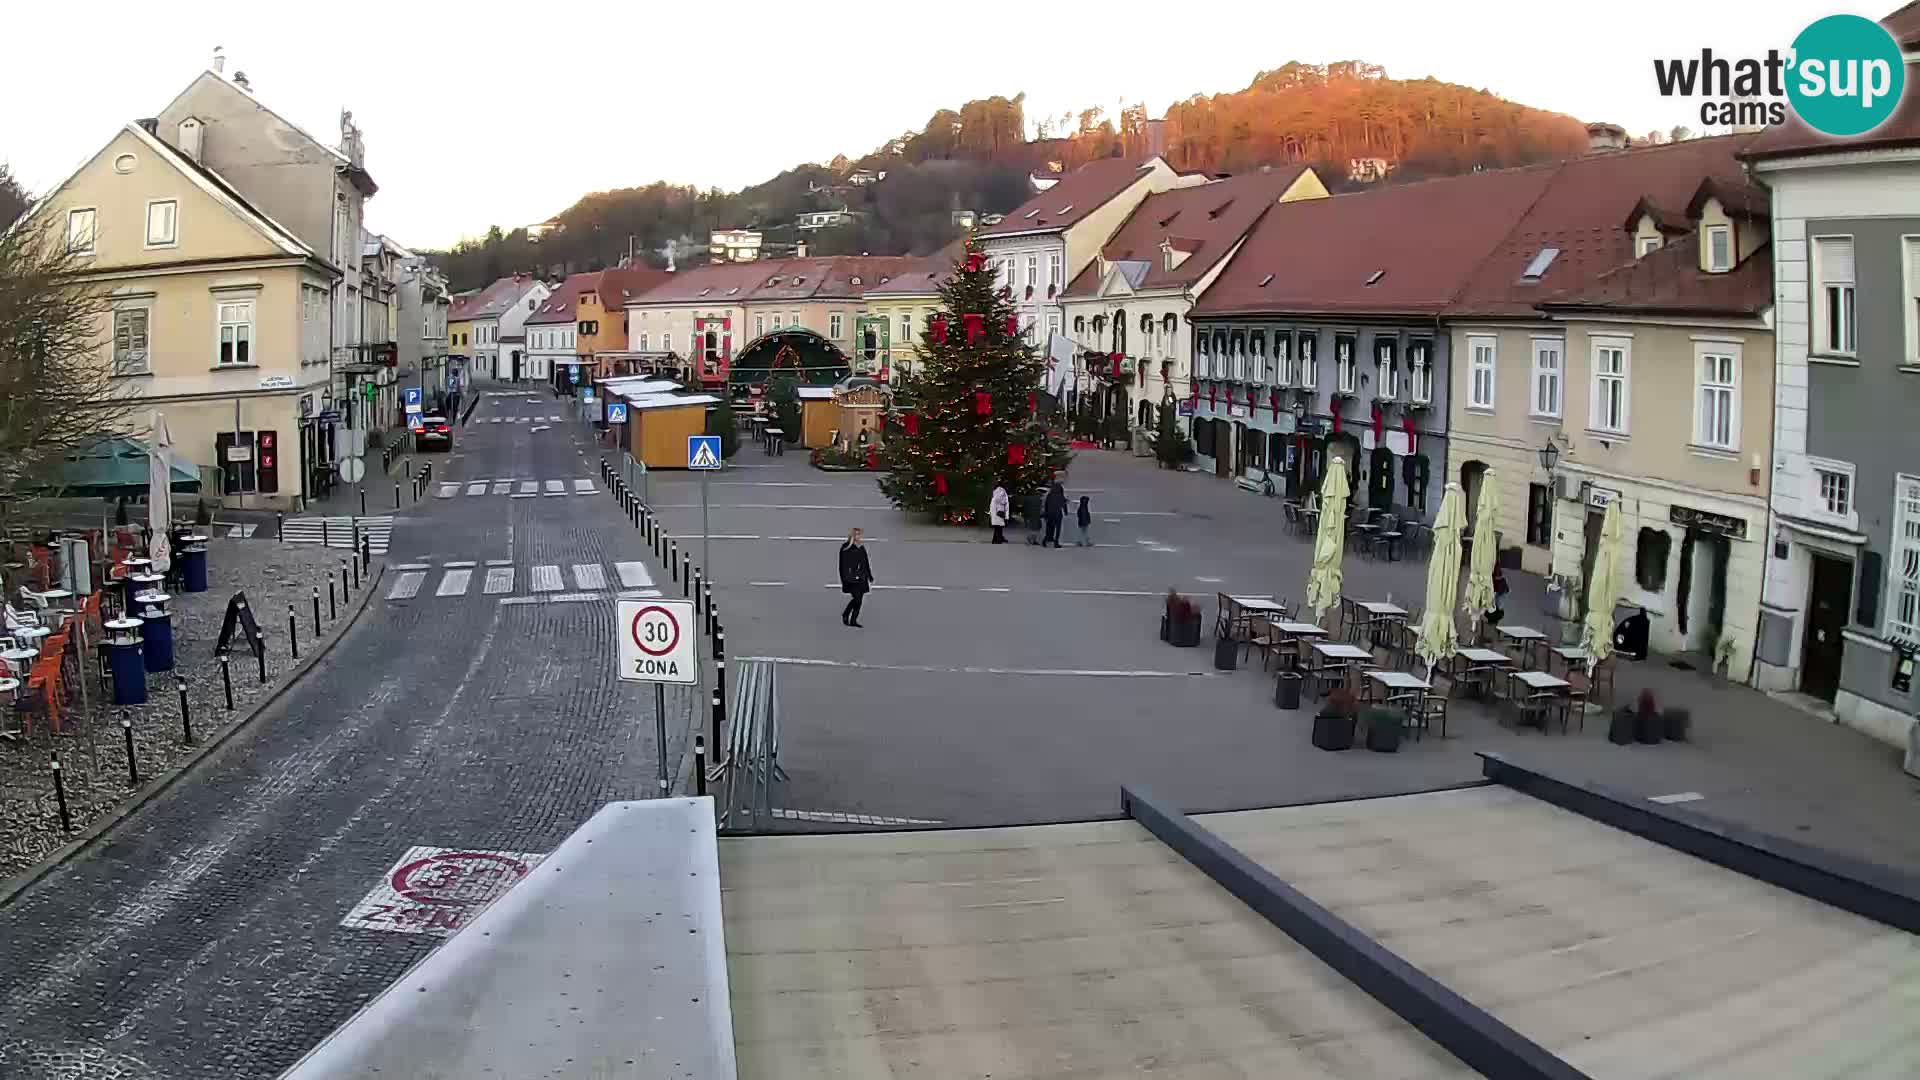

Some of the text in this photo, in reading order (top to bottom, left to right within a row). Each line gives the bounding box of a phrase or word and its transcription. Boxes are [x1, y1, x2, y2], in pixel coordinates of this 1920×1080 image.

[409, 391, 417, 403] P
[644, 622, 668, 642] 30
[634, 659, 678, 675] ZONA
